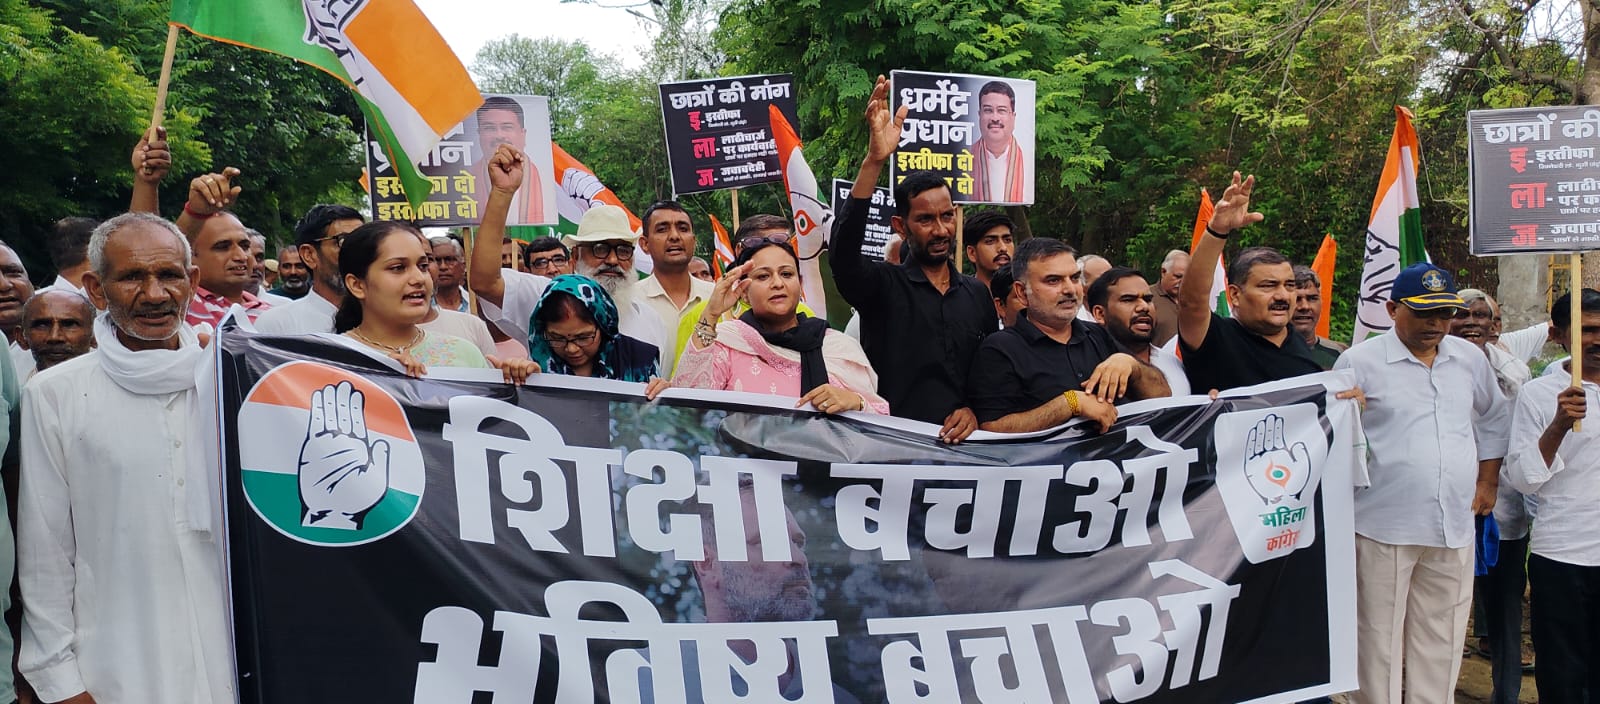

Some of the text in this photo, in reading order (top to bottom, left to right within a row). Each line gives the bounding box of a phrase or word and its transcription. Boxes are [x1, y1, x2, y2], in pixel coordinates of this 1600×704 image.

[669, 79, 790, 110] छात्रों की मांग
[900, 80, 971, 120] धर्मेंद्र
[705, 108, 741, 123] इस्तीफा
[721, 129, 765, 145] लाठीचार्ज
[898, 118, 974, 146] प्रधान
[1482, 112, 1558, 144] छात्रों
[722, 145, 737, 155] पर
[897, 148, 974, 172] इस्तीफा दो
[1535, 145, 1595, 162] इस्तीफा
[453, 170, 476, 194] दो
[956, 173, 974, 195] दो
[1557, 177, 1600, 193] लाठी
[455, 195, 478, 219] दो
[1558, 194, 1579, 206] पर
[443, 395, 1199, 562] शिक्षा बचाओ
[1258, 506, 1307, 527] महिला
[414, 559, 1242, 704] भविष्य बचाओ
